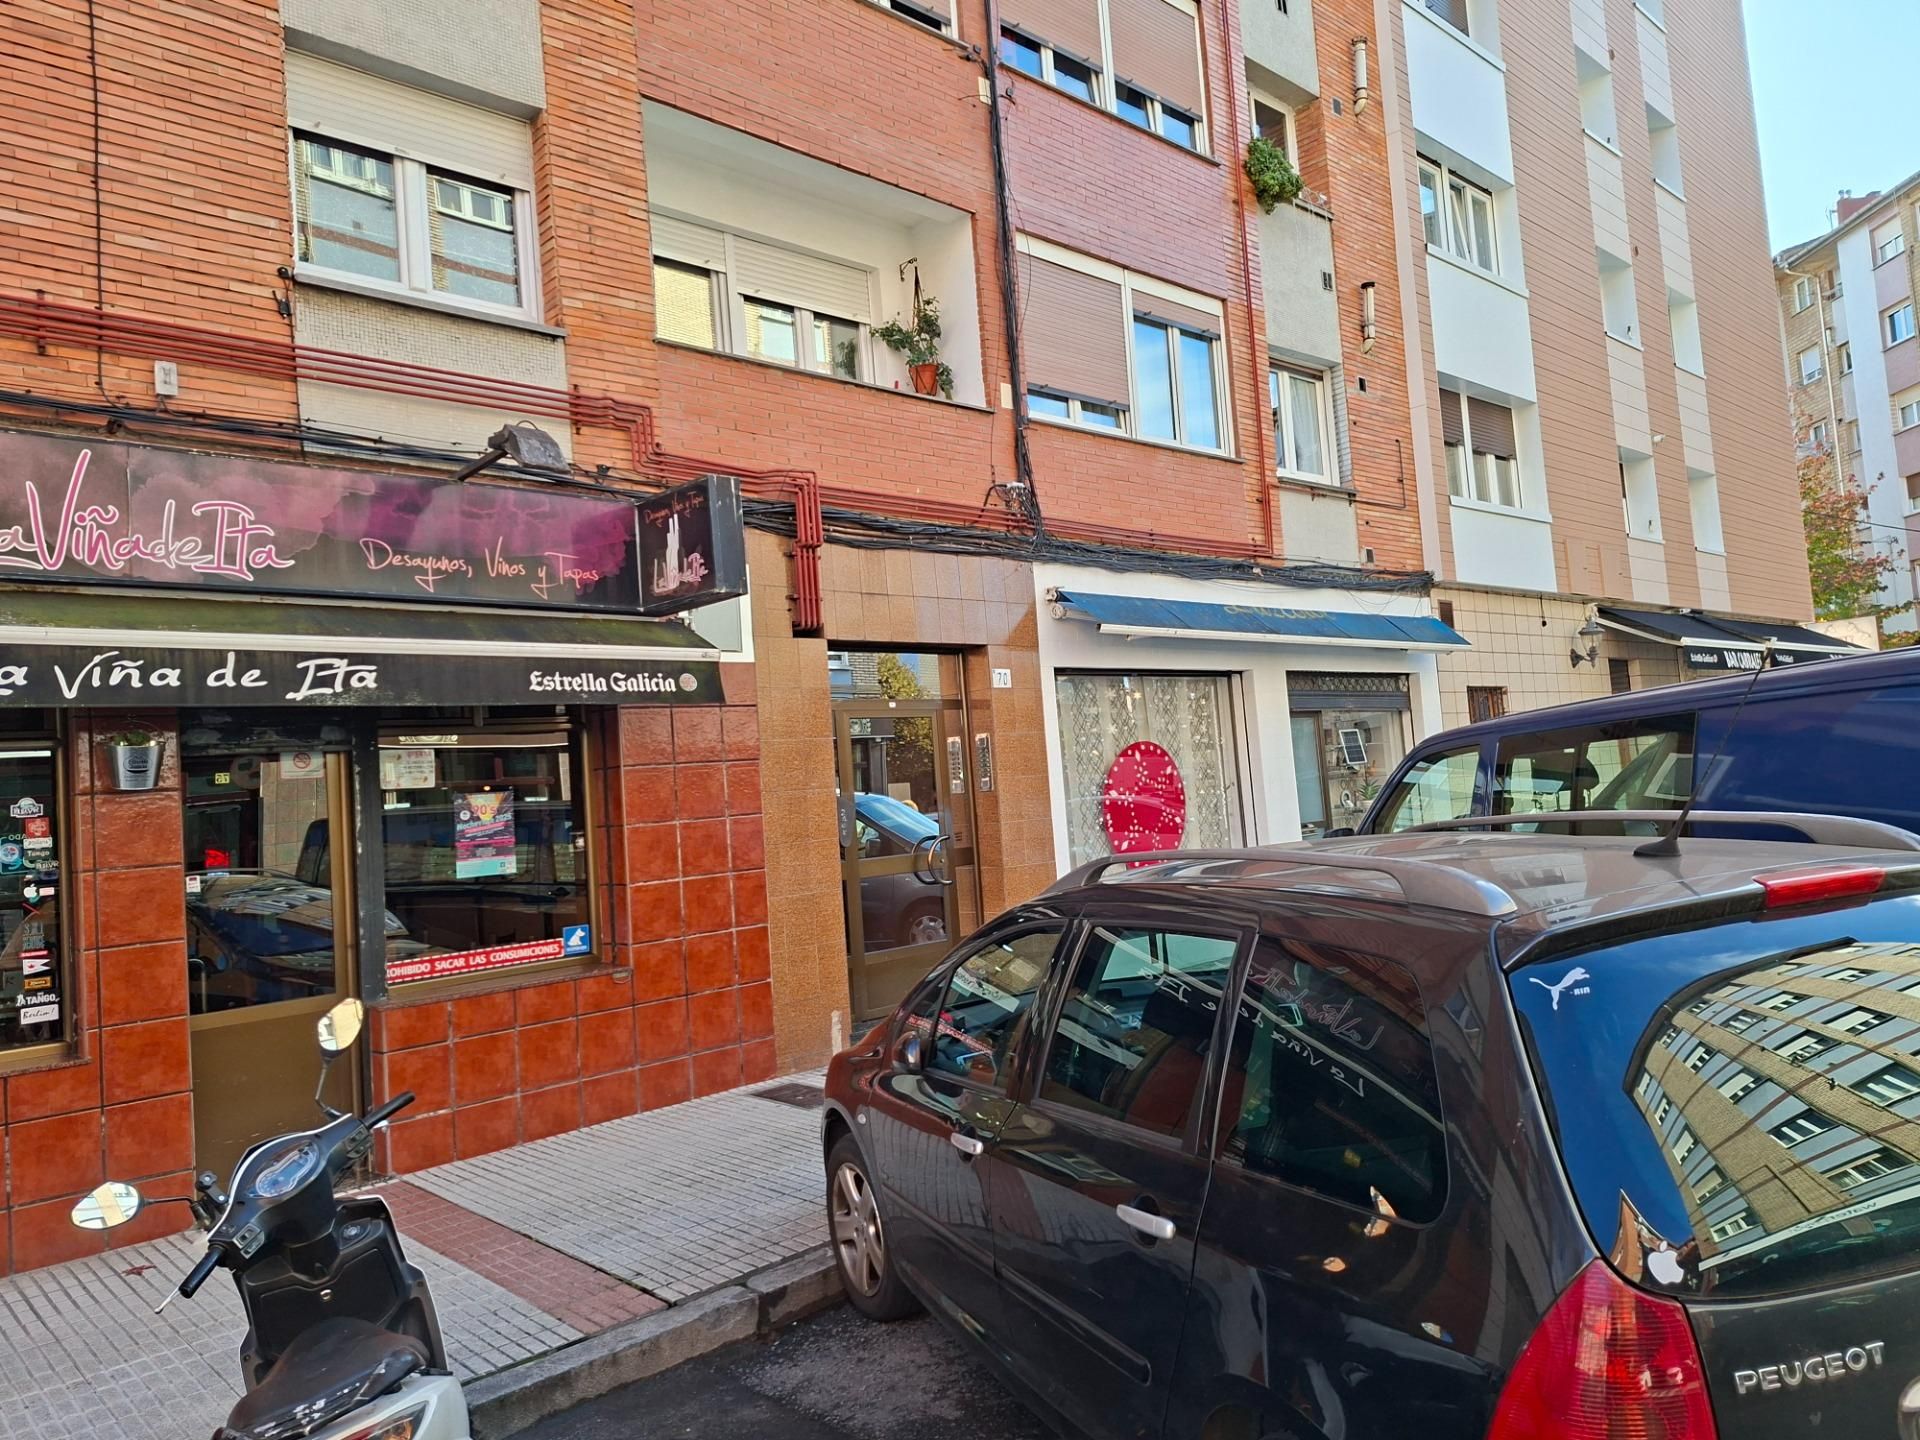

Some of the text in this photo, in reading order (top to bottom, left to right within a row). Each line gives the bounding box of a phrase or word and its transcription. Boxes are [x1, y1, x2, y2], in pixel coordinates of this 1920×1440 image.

[359, 536, 599, 600] Desayunos, Vinos y Tapas
[0, 651, 377, 700] a Viña de Ita
[529, 671, 677, 692] Estrella Galicia
[997, 672, 1008, 686] 70
[435, 958, 466, 970] SACAR
[469, 954, 487, 965] LAS
[490, 944, 560, 962] CONSUMICIONES
[1734, 1341, 1885, 1394] PEUGEOT
